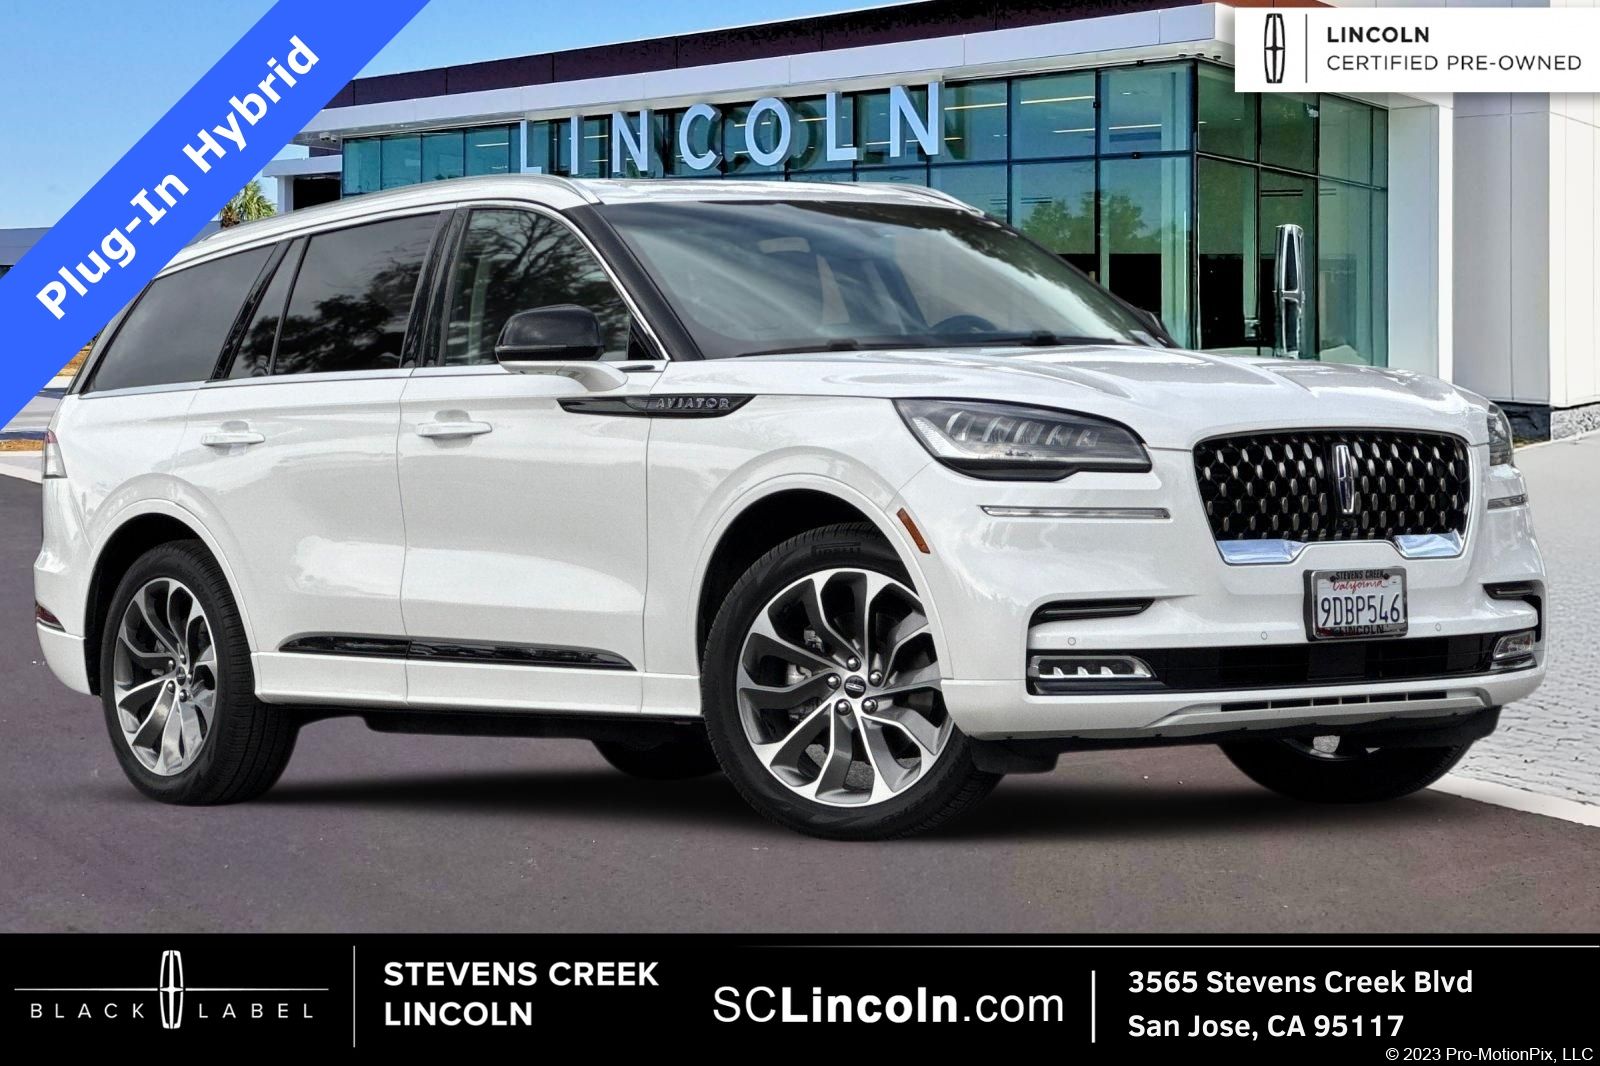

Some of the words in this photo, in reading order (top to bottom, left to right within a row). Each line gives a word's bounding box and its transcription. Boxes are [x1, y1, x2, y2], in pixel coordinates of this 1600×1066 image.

[520, 81, 942, 175] LINCOLN
[655, 397, 731, 410] AVIATOR
[1335, 570, 1363, 580] STEVENS
[1365, 569, 1385, 580] CREEK
[1332, 580, 1388, 594] California
[1321, 594, 1401, 627] 9DBP546
